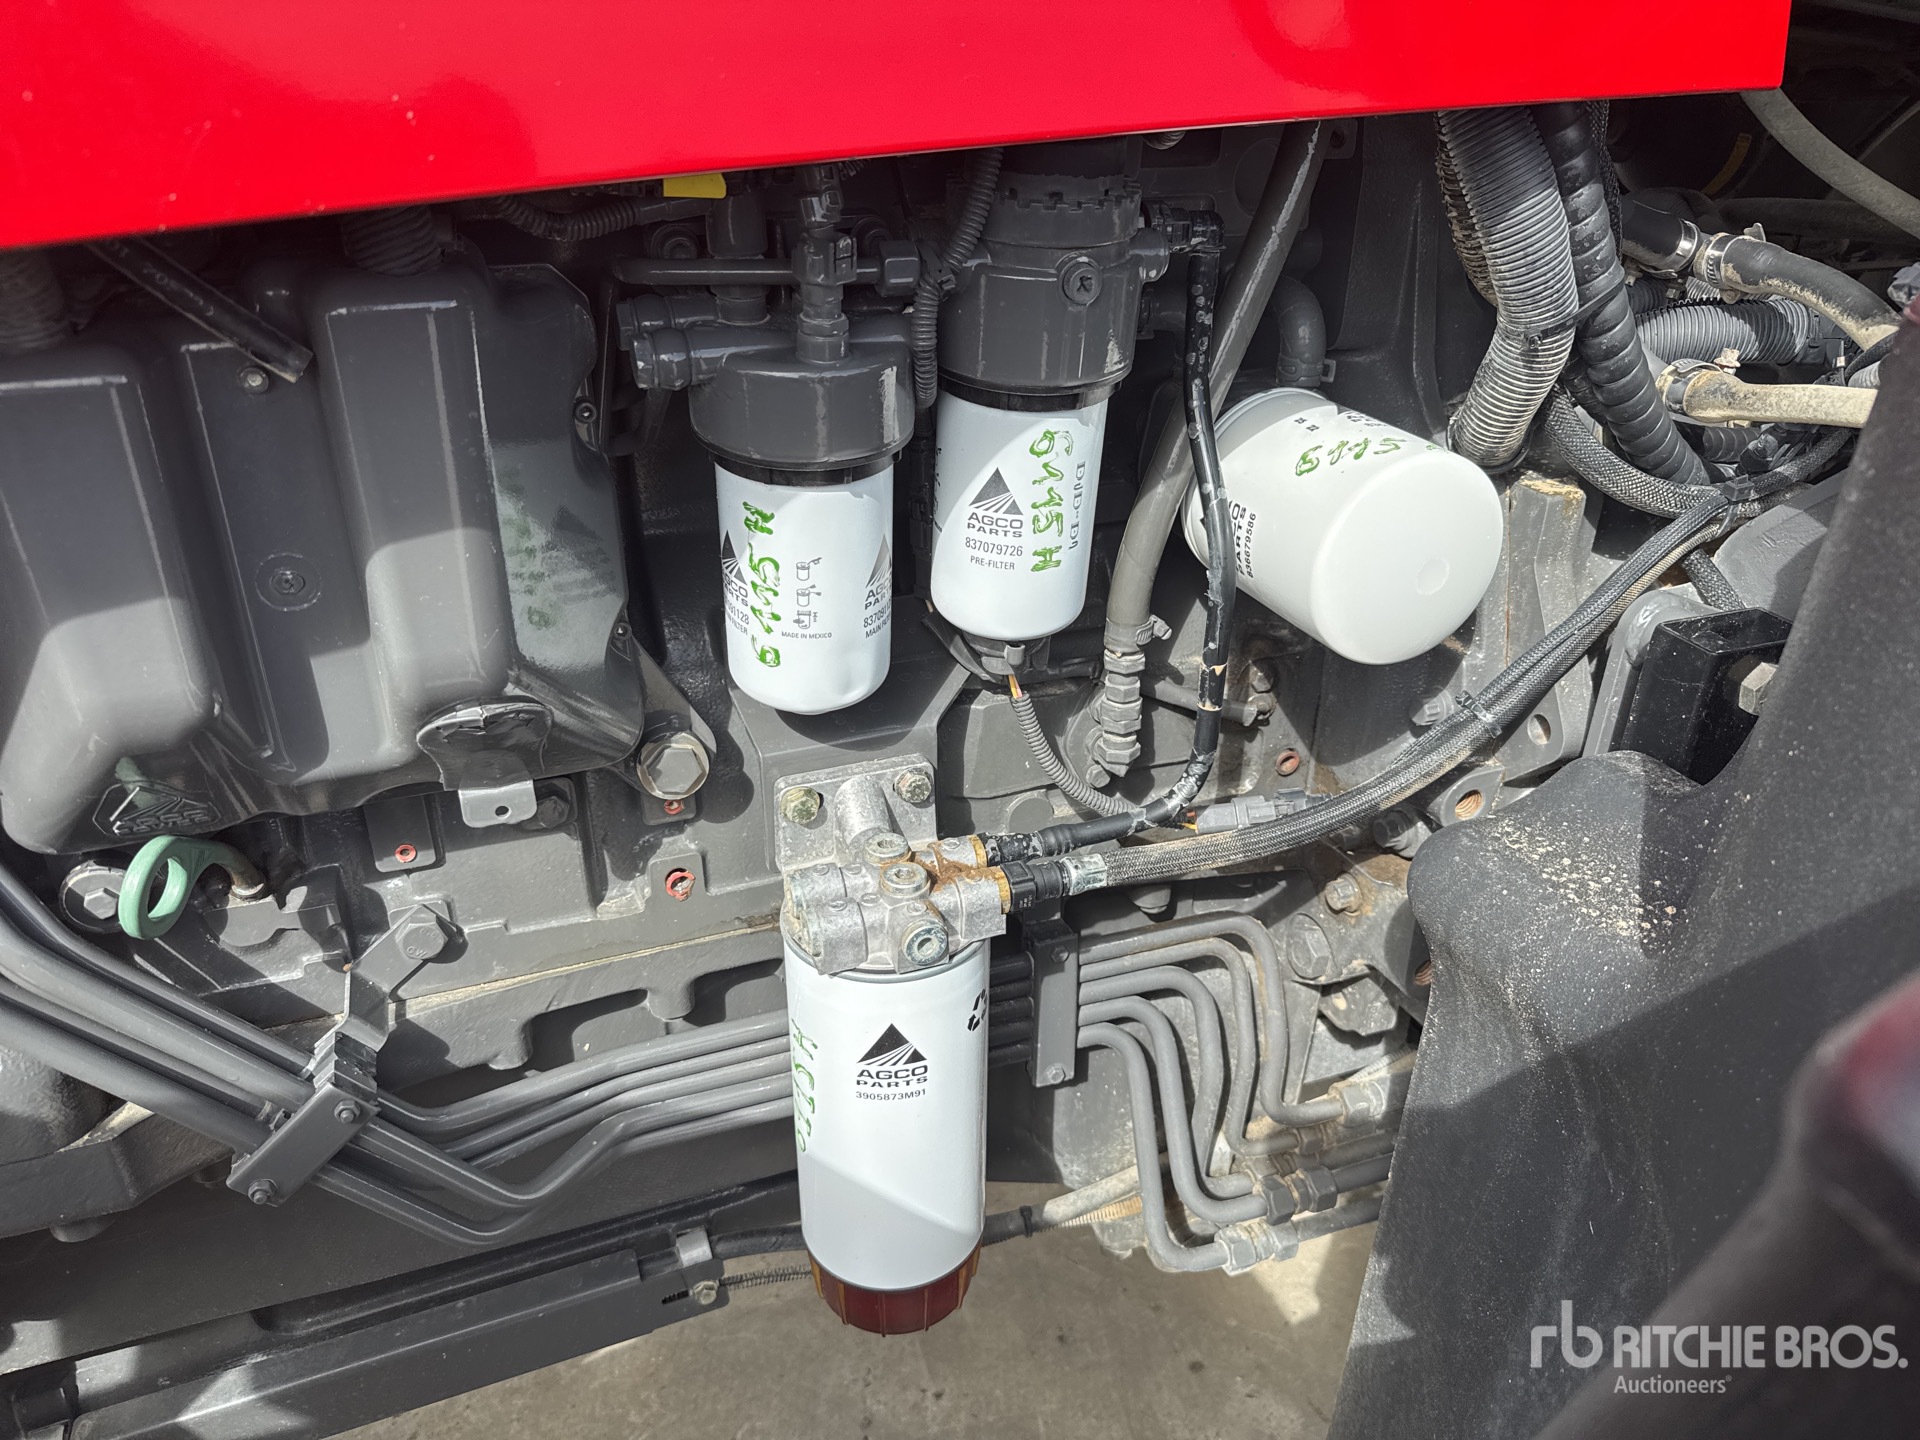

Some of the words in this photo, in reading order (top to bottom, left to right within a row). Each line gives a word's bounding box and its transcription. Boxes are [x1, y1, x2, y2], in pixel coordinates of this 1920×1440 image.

[967, 512, 1024, 530] AGCO
[967, 522, 1023, 538] PARTS
[965, 537, 1024, 557] 837079726
[1245, 512, 1257, 579] 836679586
[970, 555, 1015, 571] PRE-FILTER
[723, 571, 748, 598] GCO
[781, 631, 800, 639] MADE
[865, 626, 882, 643] MAIN
[857, 1065, 929, 1080] AGCO
[856, 1076, 928, 1088] PARTS
[856, 1088, 927, 1101] 3905873M91
